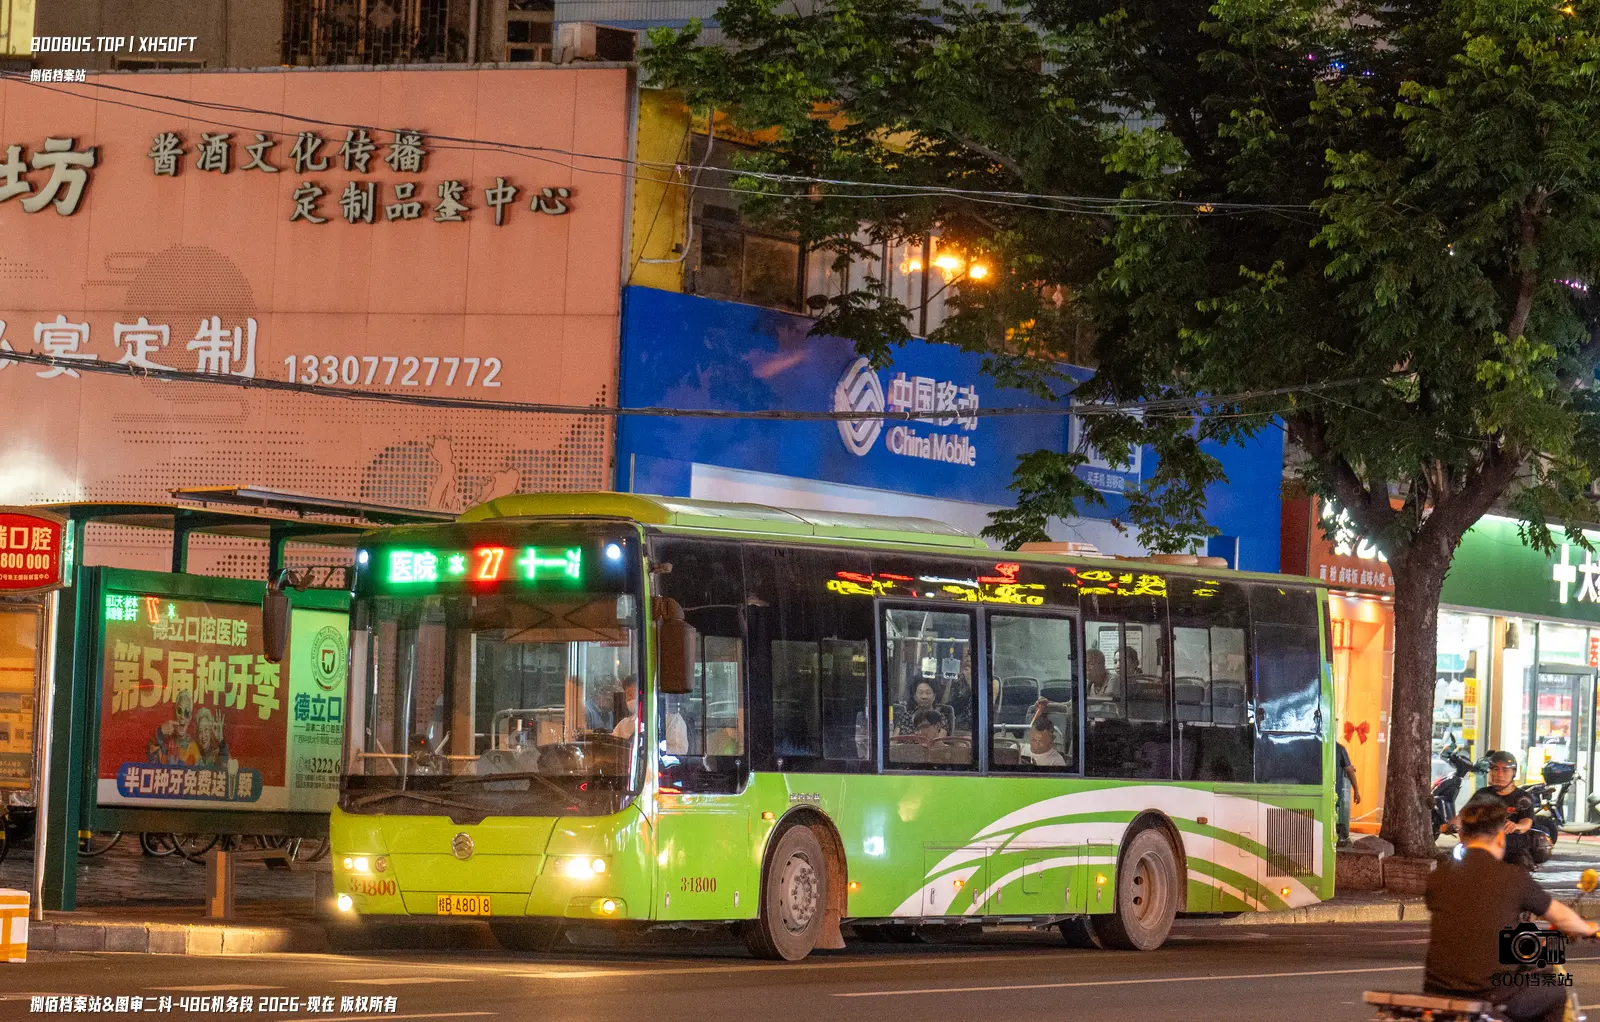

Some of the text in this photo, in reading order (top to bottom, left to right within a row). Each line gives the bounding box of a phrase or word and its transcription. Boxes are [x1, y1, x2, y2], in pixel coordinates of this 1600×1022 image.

[148, 128, 430, 177] 酱酒文化传播
[289, 177, 572, 226] 定制品鉴中心
[282, 353, 502, 389] 13307727772
[888, 372, 980, 431] 中国移动
[886, 425, 977, 467] China Mobile
[0, 552, 50, 570] 800 000
[389, 550, 437, 582] 医院
[479, 547, 504, 580] 27
[1578, 549, 1600, 603] 大
[151, 612, 248, 647] 德立口腔医院
[111, 639, 281, 721] 第5届种牙季
[124, 766, 227, 798] 半口种牙免费送
[310, 757, 333, 774] 3222
